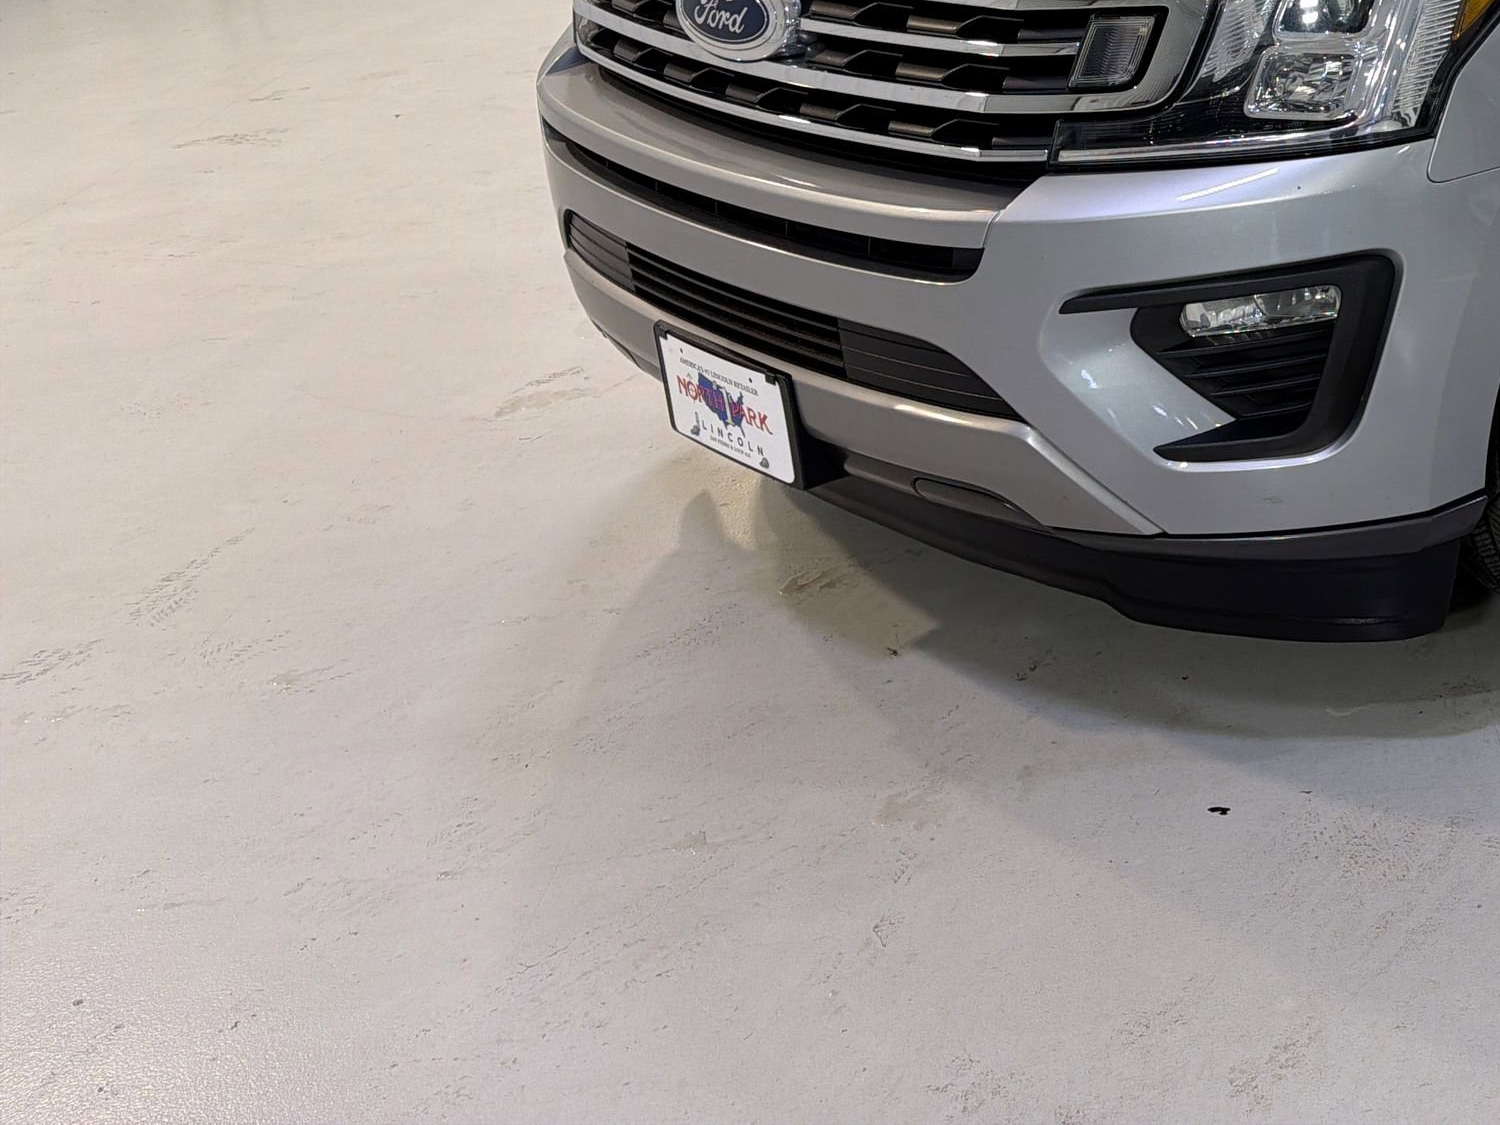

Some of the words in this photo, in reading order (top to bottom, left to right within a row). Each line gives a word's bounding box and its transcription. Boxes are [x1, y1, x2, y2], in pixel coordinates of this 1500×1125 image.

[676, 374, 725, 412] NORTH
[730, 401, 774, 436] PARK
[702, 419, 765, 457] LINCOLN
